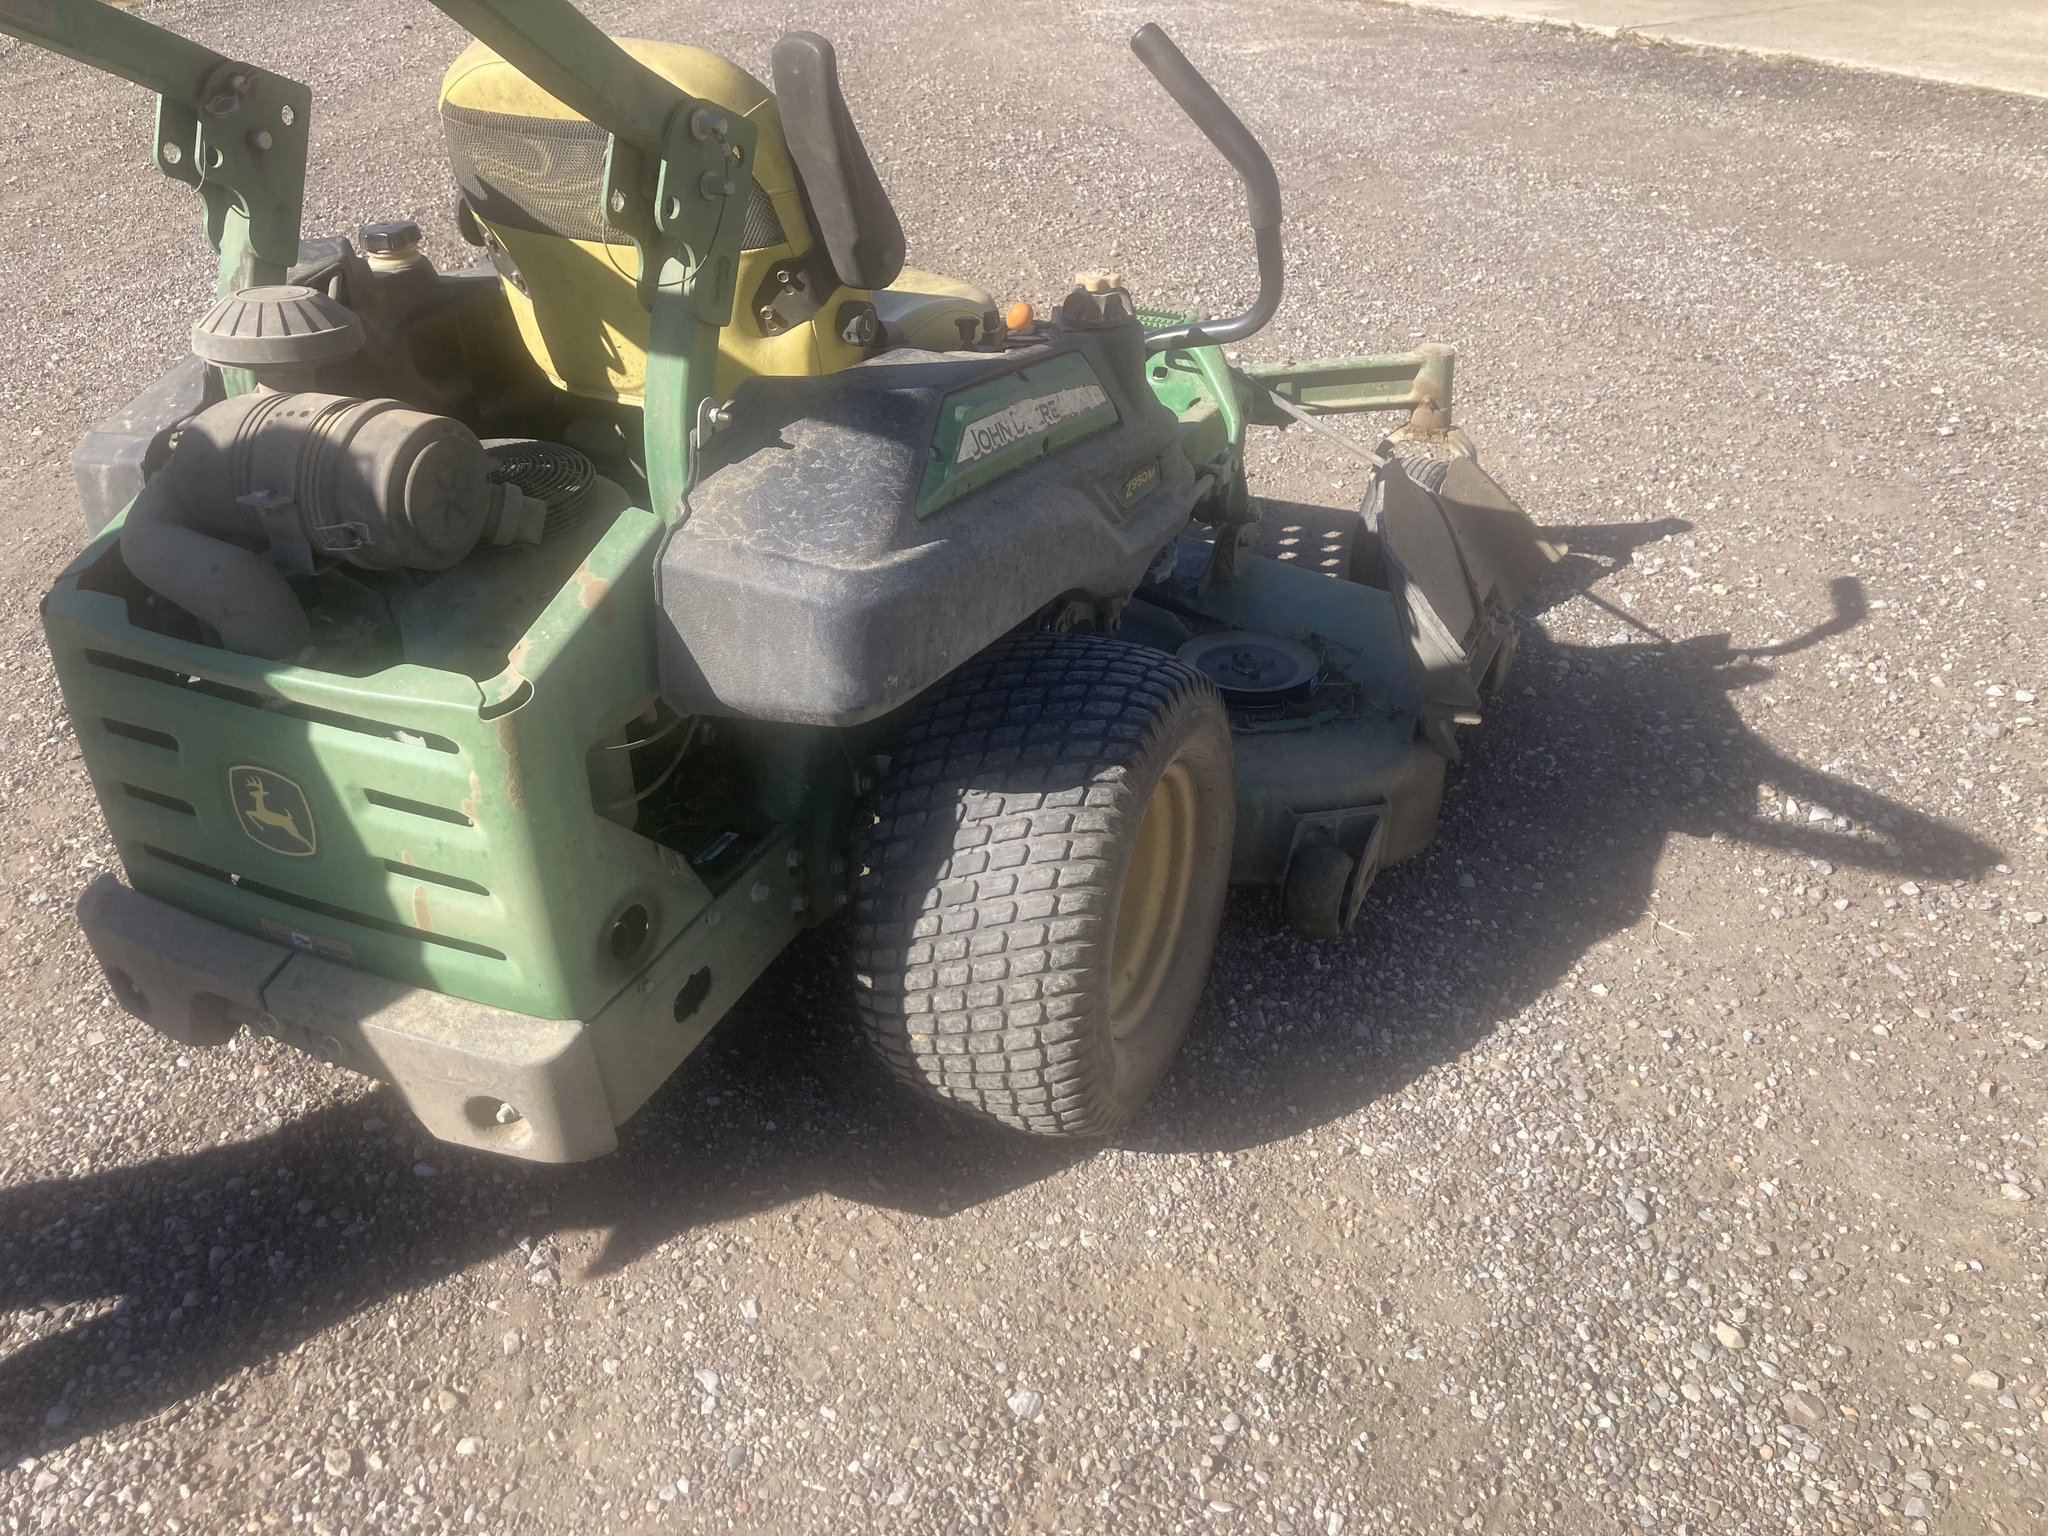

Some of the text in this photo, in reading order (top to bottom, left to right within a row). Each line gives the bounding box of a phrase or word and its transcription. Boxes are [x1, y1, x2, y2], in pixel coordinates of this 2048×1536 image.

[970, 400, 1061, 456] JOHN DRE
[1126, 466, 1155, 498] Z950M
